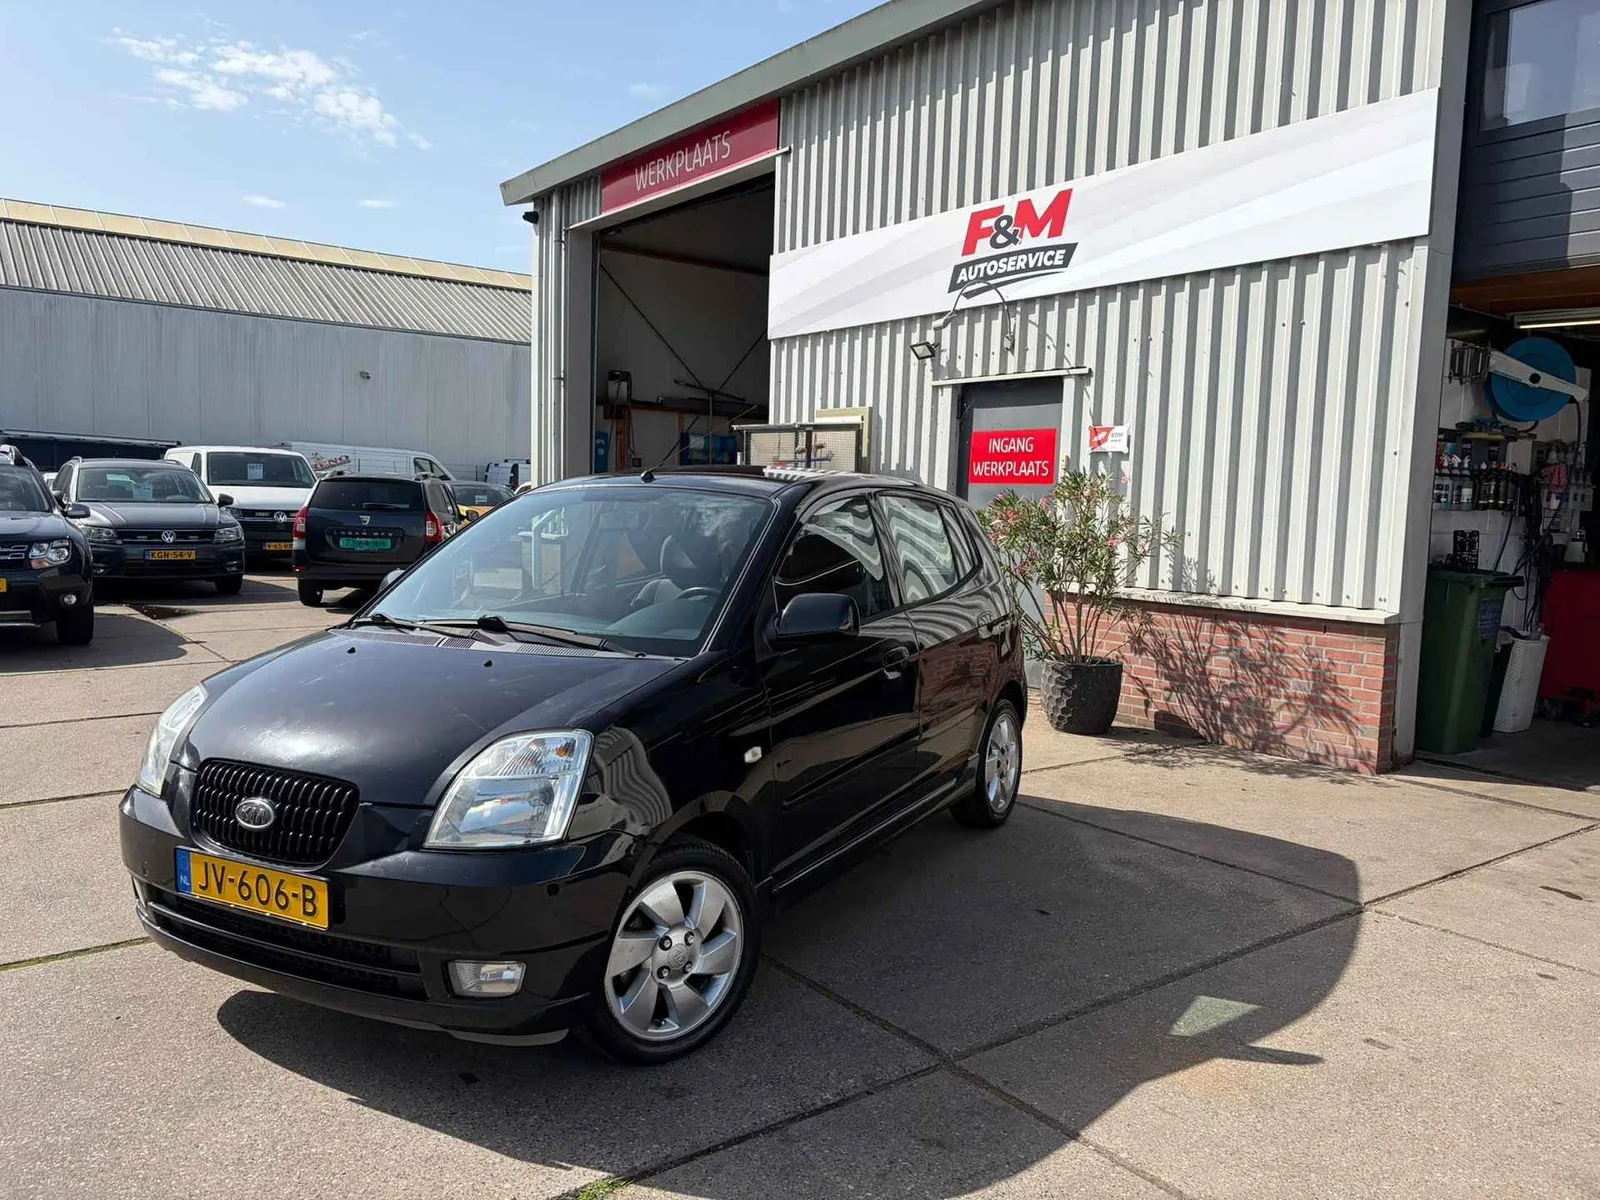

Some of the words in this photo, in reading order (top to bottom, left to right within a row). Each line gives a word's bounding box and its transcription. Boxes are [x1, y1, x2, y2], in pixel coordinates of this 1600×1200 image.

[634, 130, 732, 192] WERKPLAATS
[961, 187, 1073, 256] F&M
[956, 249, 1067, 285] AUTOSERVICE
[988, 436, 1034, 453] INGANG
[973, 460, 1049, 477] WERKPLAATS
[151, 551, 193, 559] KGN-54-V
[180, 875, 190, 886] NL
[198, 861, 318, 918] JV-606-B
